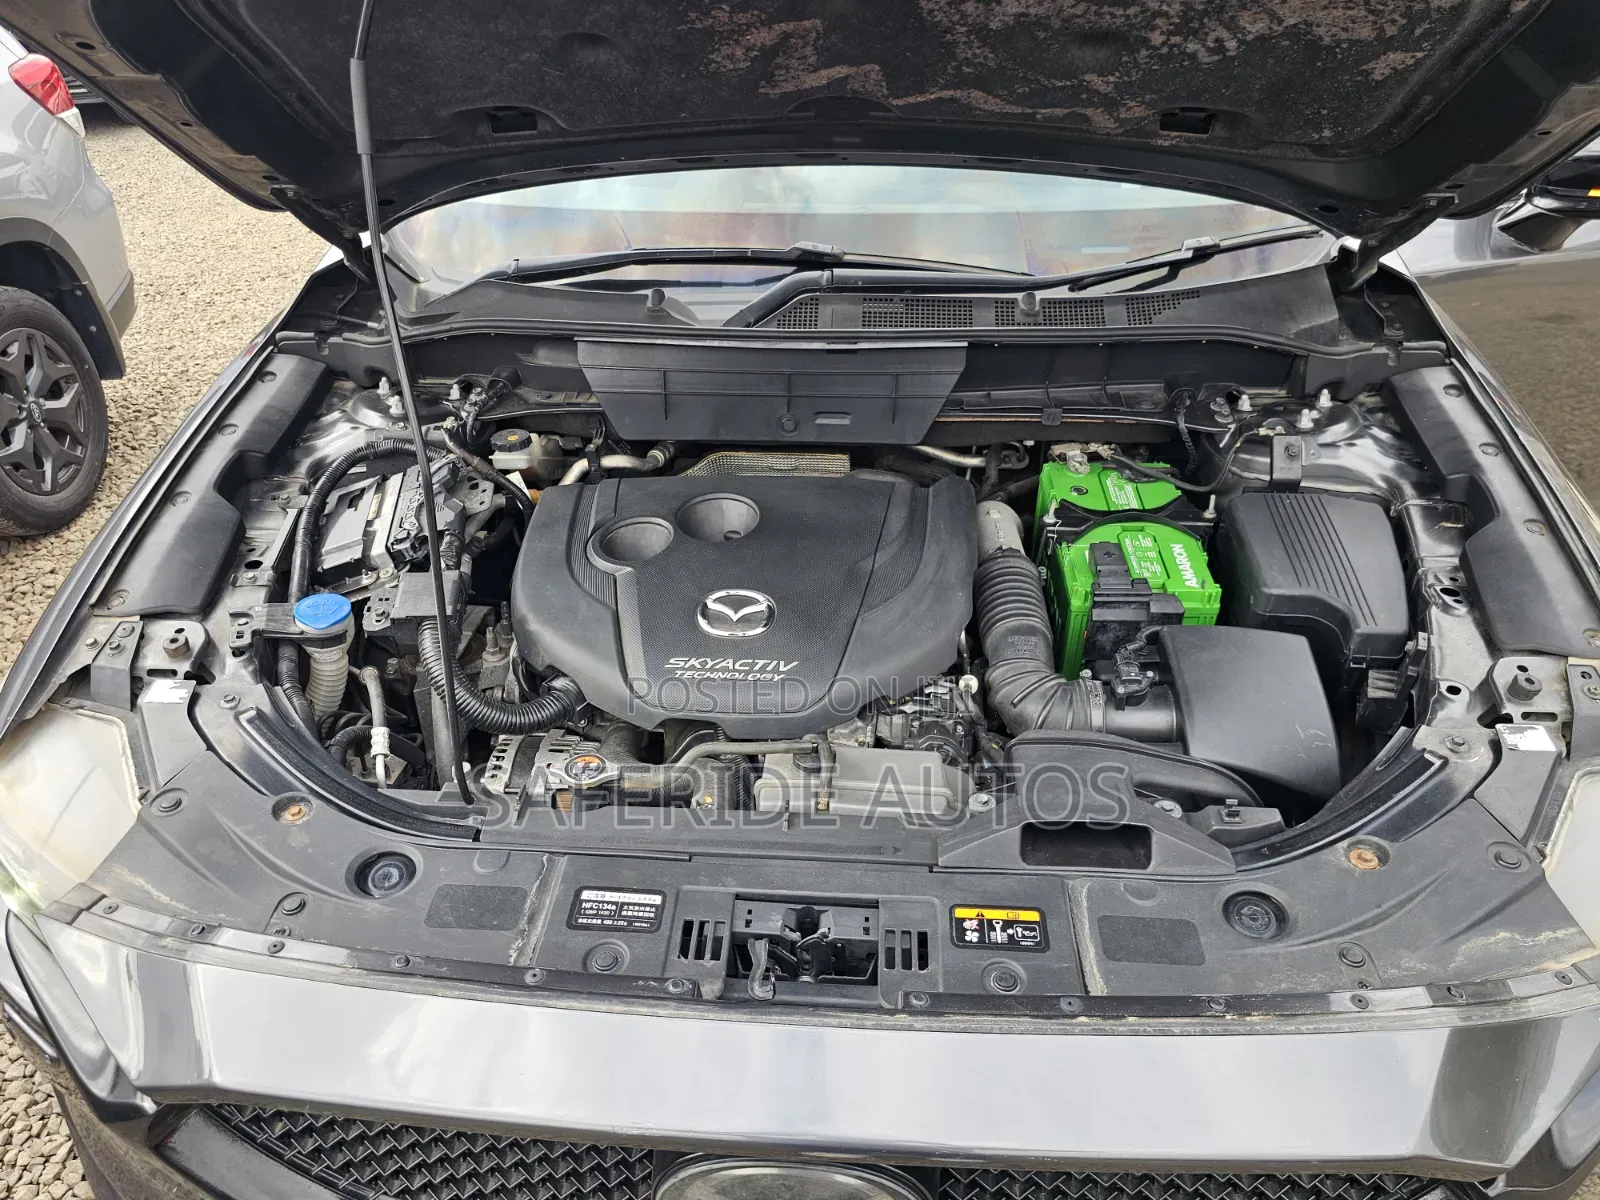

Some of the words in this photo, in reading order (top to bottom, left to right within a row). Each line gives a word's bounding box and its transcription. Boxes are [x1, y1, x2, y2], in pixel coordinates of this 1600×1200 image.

[1170, 543, 1200, 588] AMARON
[664, 657, 799, 671] SKYACTIV
[674, 670, 785, 682] TECHNOLOGY
[581, 902, 617, 910] HFC134a
